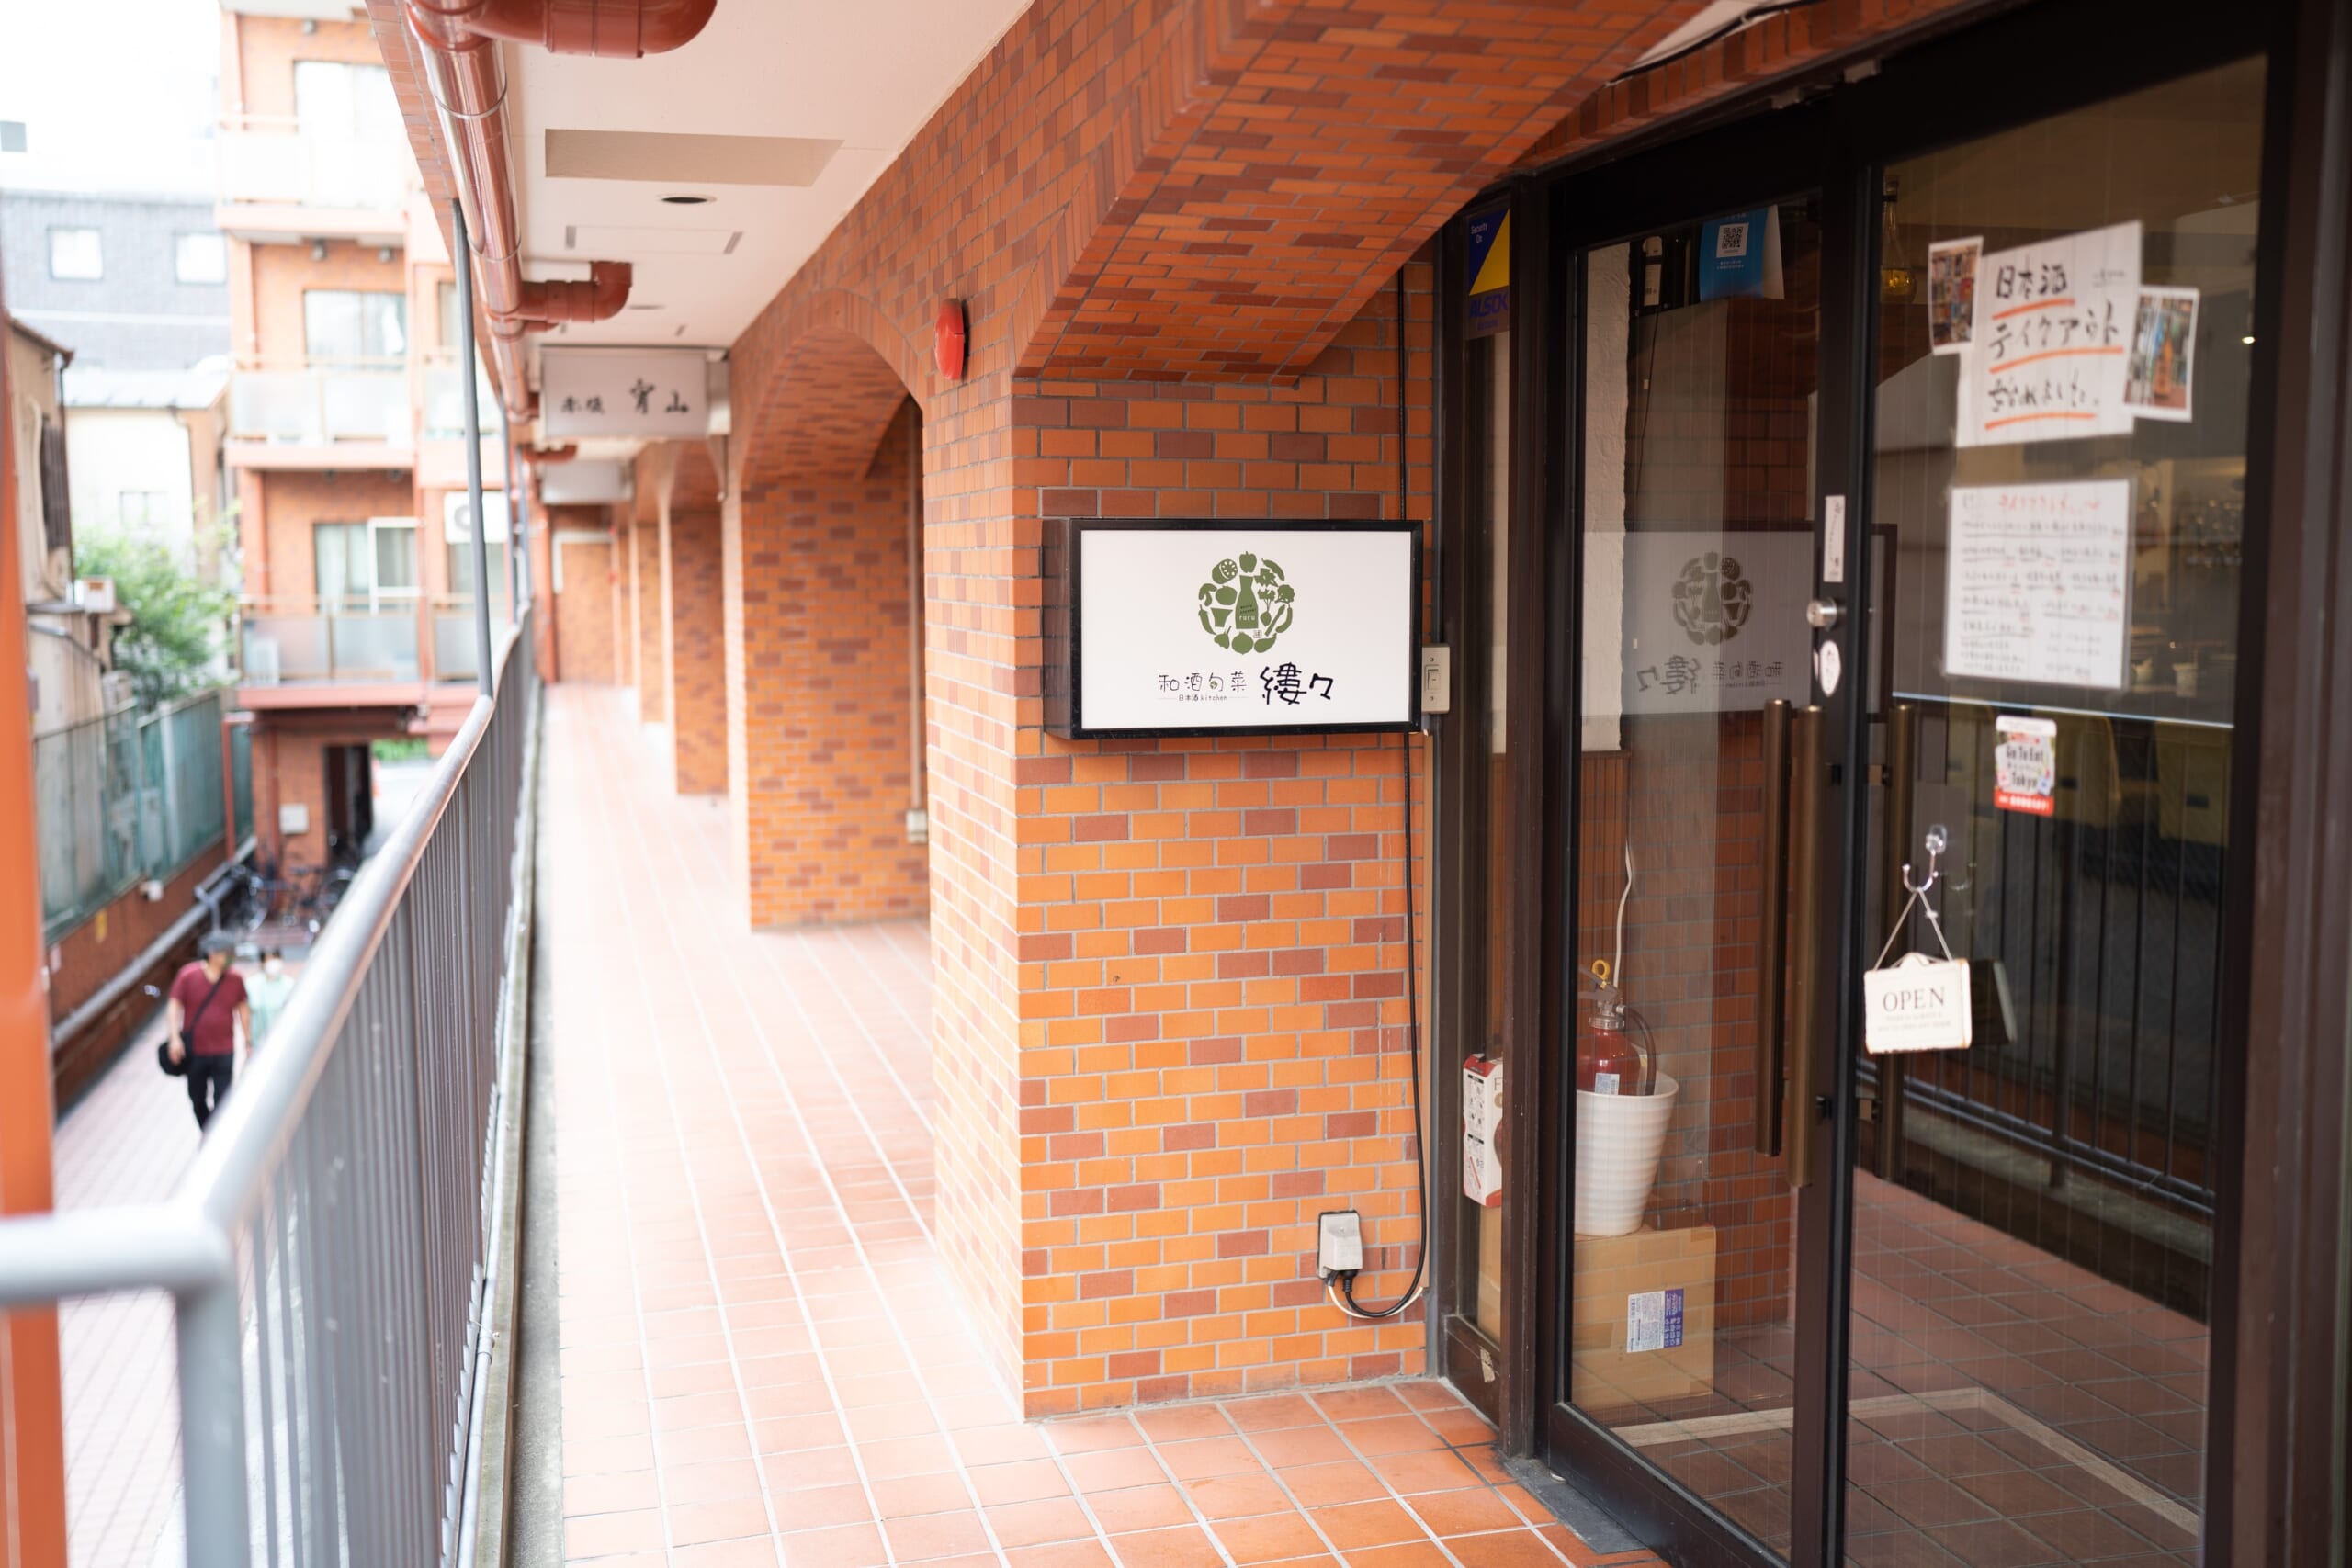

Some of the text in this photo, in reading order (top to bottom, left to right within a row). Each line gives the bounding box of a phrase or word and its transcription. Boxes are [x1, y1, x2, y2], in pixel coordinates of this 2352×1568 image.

[1995, 254, 2068, 299] 日本酒
[1469, 293, 1508, 318] ALSOK
[1158, 661, 1334, 705] 和酒旬菜 縷々
[1883, 986, 1945, 1012] OPEN
